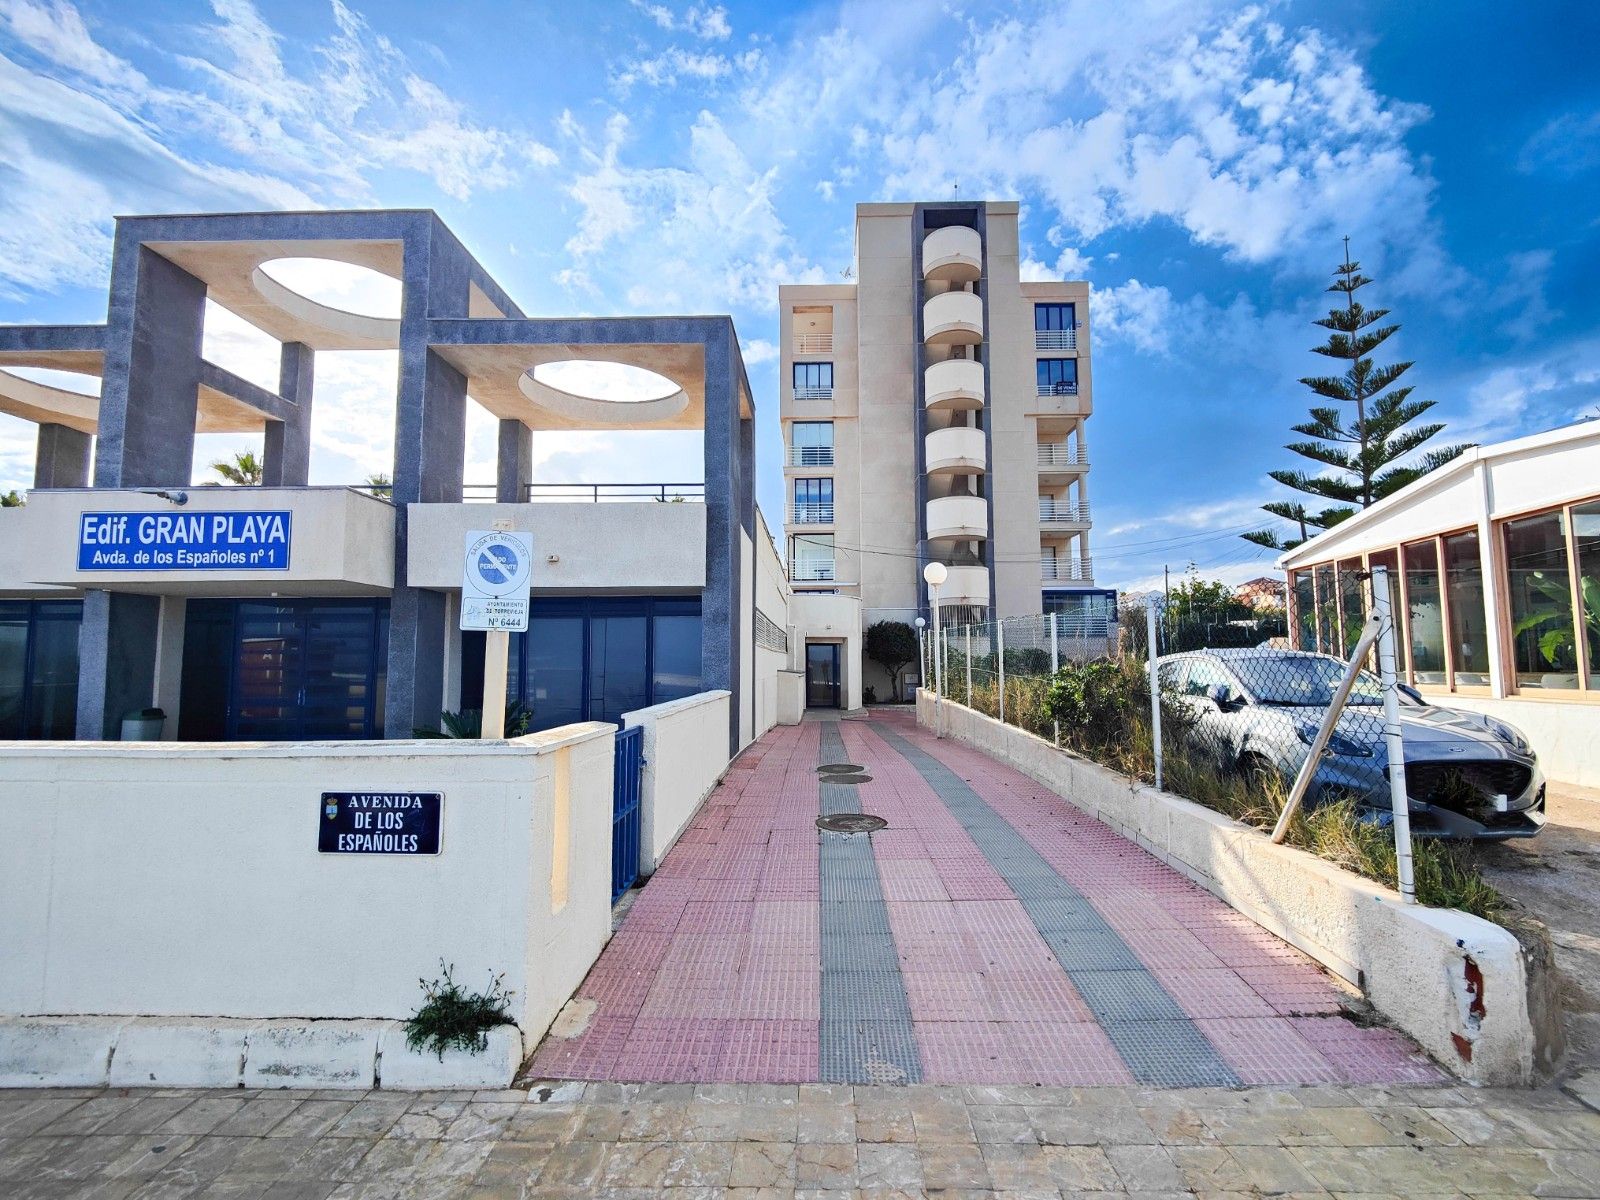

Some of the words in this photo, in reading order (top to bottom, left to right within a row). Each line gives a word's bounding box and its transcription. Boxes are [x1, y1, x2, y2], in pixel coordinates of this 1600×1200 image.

[82, 516, 130, 544] Edif.
[138, 516, 204, 544] GRAN
[212, 516, 285, 544] PLAYA
[471, 539, 488, 556] SALIDA
[92, 551, 129, 564] Avda.
[134, 550, 149, 564] de
[154, 550, 172, 564] los
[177, 550, 246, 566] Españoles
[268, 550, 274, 563] 1
[348, 796, 422, 808] AVENIDA
[354, 812, 372, 829] DE
[378, 812, 403, 829] LOS
[338, 831, 418, 852] ESPAÑOLES
